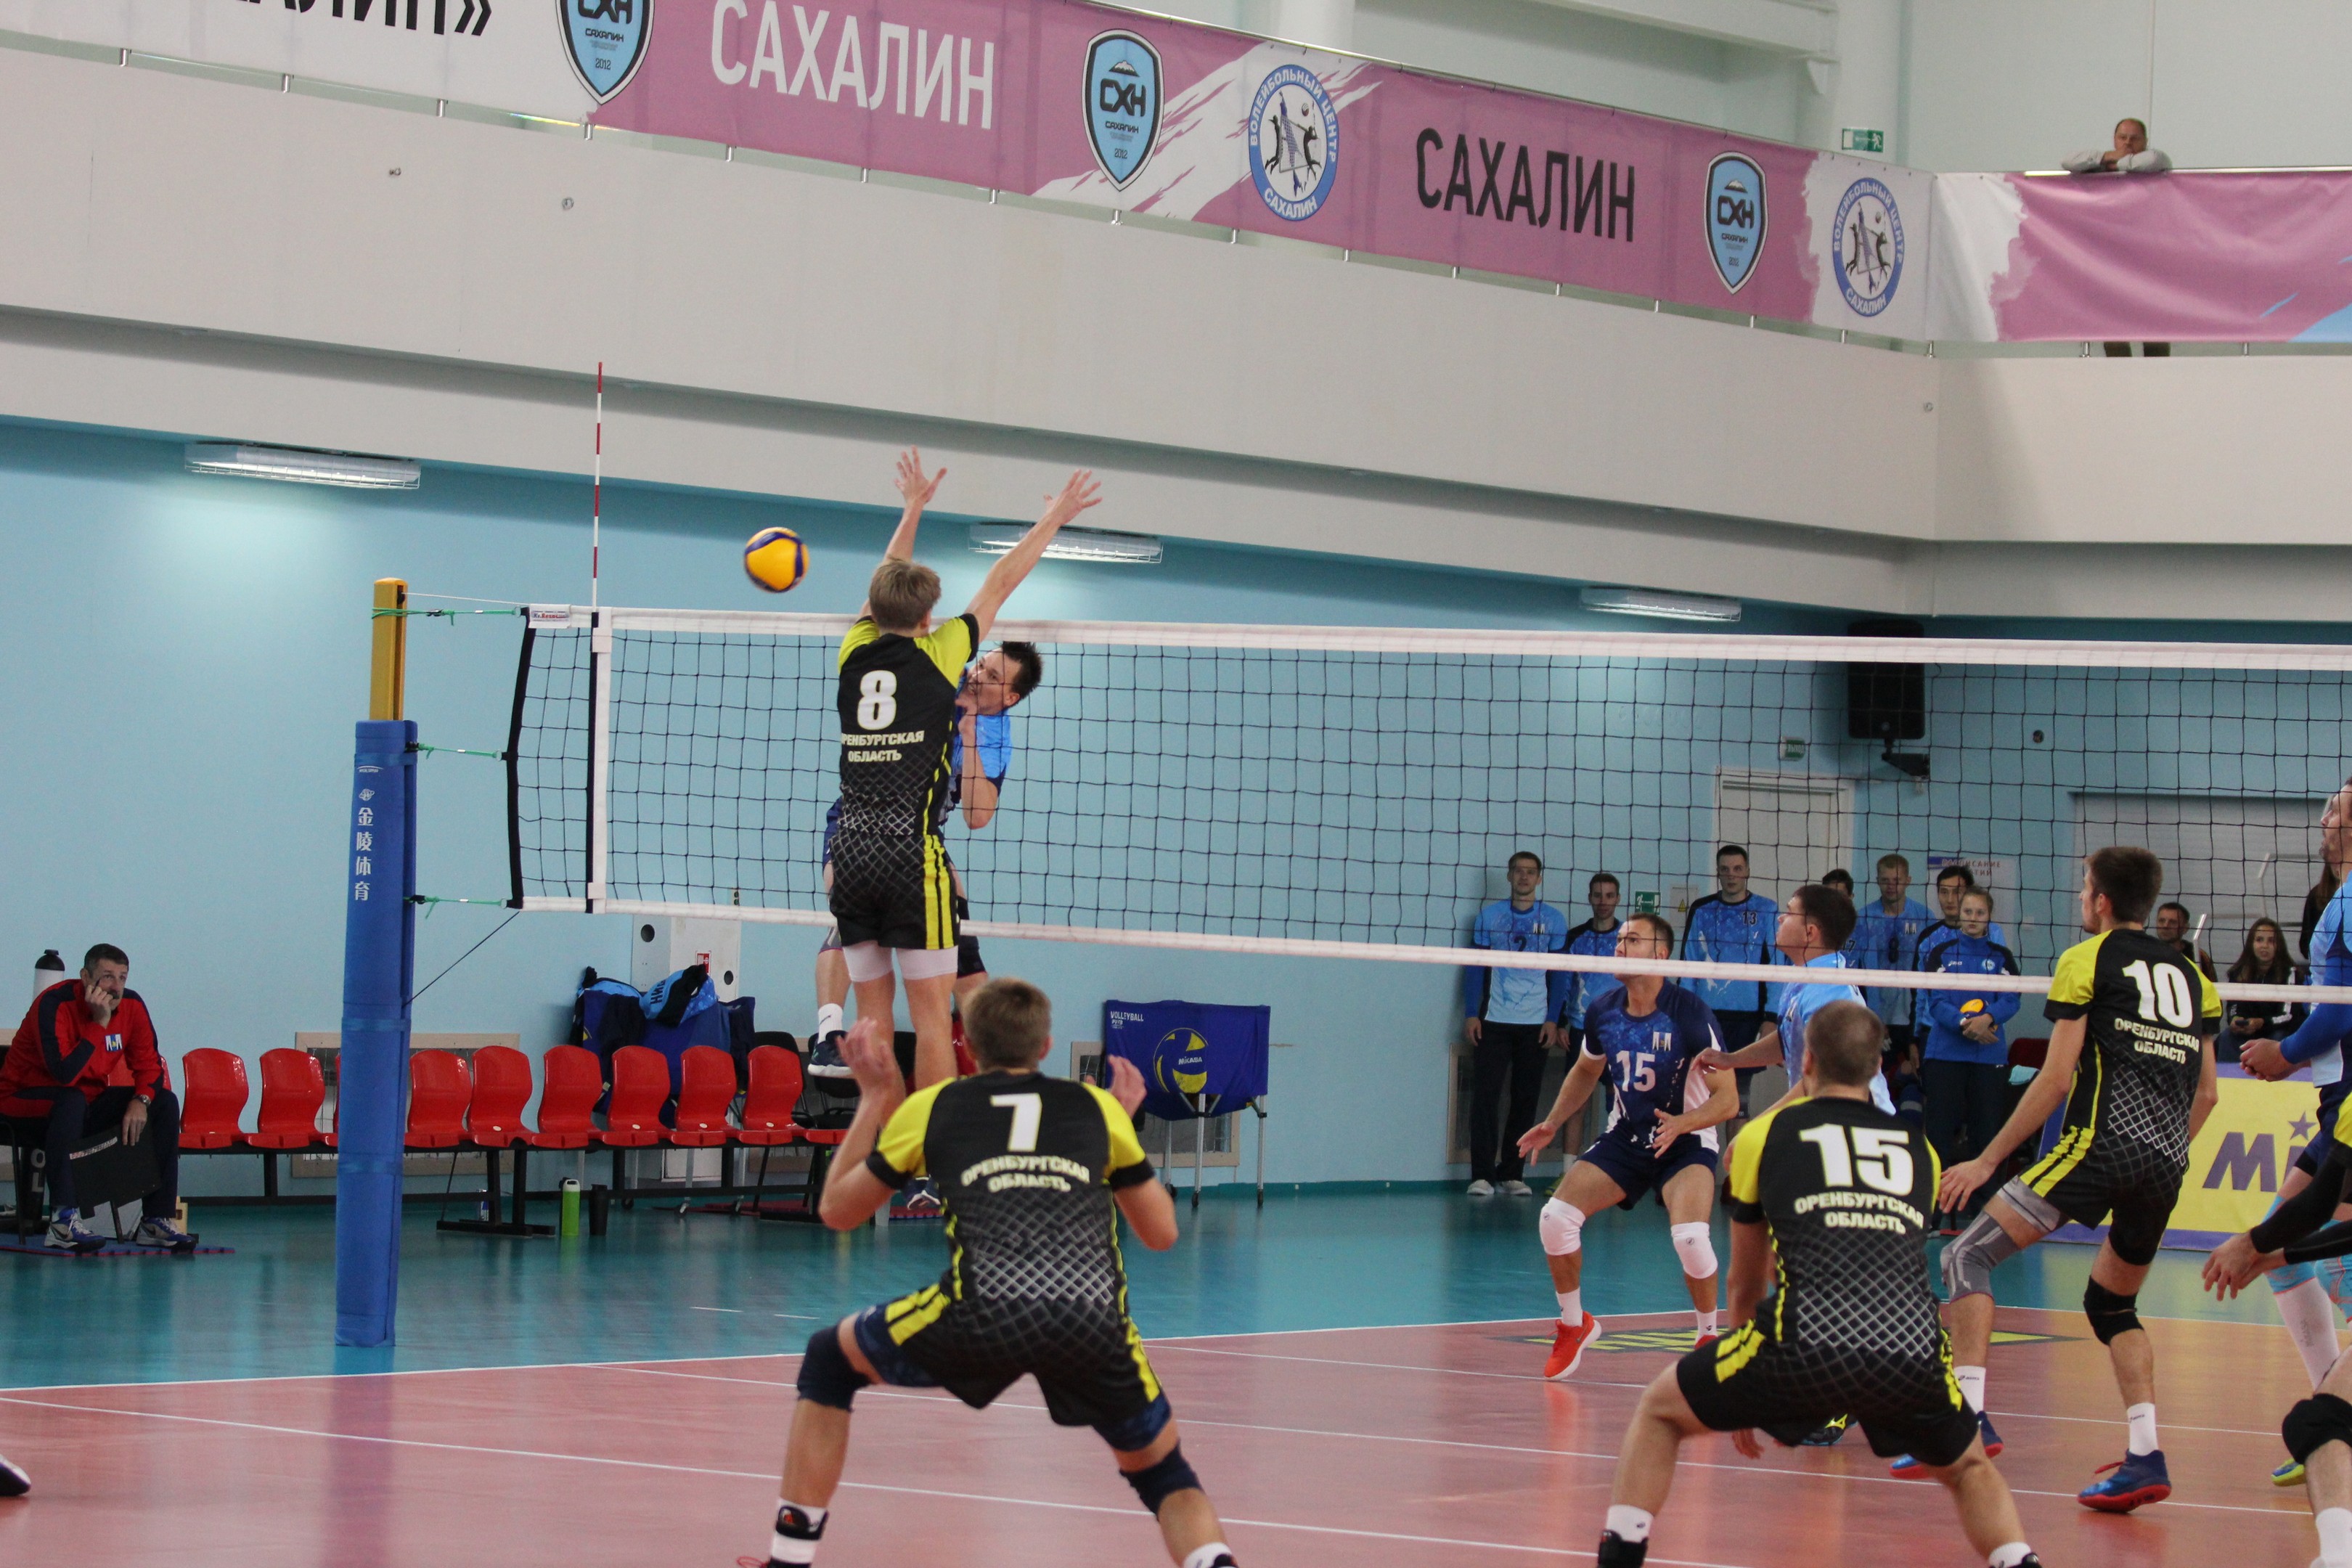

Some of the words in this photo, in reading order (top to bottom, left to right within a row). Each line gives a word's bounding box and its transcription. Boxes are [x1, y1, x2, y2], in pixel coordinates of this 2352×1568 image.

[585, 28, 624, 42] САХАЛИН
[595, 58, 611, 70] 2012
[711, 0, 995, 130] САХАЛИН
[1250, 68, 1322, 146] ВОЛЕЙБОЛЬНЫЙ
[1320, 101, 1337, 163] ЦЕНТР
[1114, 148, 1128, 159] 2012
[1416, 127, 1635, 242] САХАЛИН
[1264, 187, 1318, 219] САХАЛИН
[1833, 181, 1892, 252] ВОЛЕЙБОЛЬНЫЙ
[1890, 208, 1905, 264] ЦЕНТР
[1846, 287, 1887, 314] САХАЛИН
[857, 669, 897, 731] 8
[841, 730, 926, 746] РЕНБУРГСКАЯ
[848, 749, 902, 763] ОБЛАСТЬ
[354, 807, 375, 902] 金陵体育
[1742, 910, 1757, 926] 13
[2122, 959, 2193, 1029] 10
[1110, 1010, 1144, 1022] VOLLEYBALL
[2114, 1018, 2200, 1053] ОРЕНБУРГСКАЯ
[2134, 1040, 2186, 1064] ОБЛАСТЬ
[1615, 1050, 1656, 1093] 15
[960, 1154, 1090, 1187] ОРЕНБУРГСКАЯ
[1799, 1123, 1914, 1196] 15
[987, 1172, 1071, 1193] ОБЛАСТЬ
[1794, 1191, 1924, 1229] ОРЕНБУРГСКАЯ
[1824, 1212, 1906, 1235] ОБЛАСТЬ
